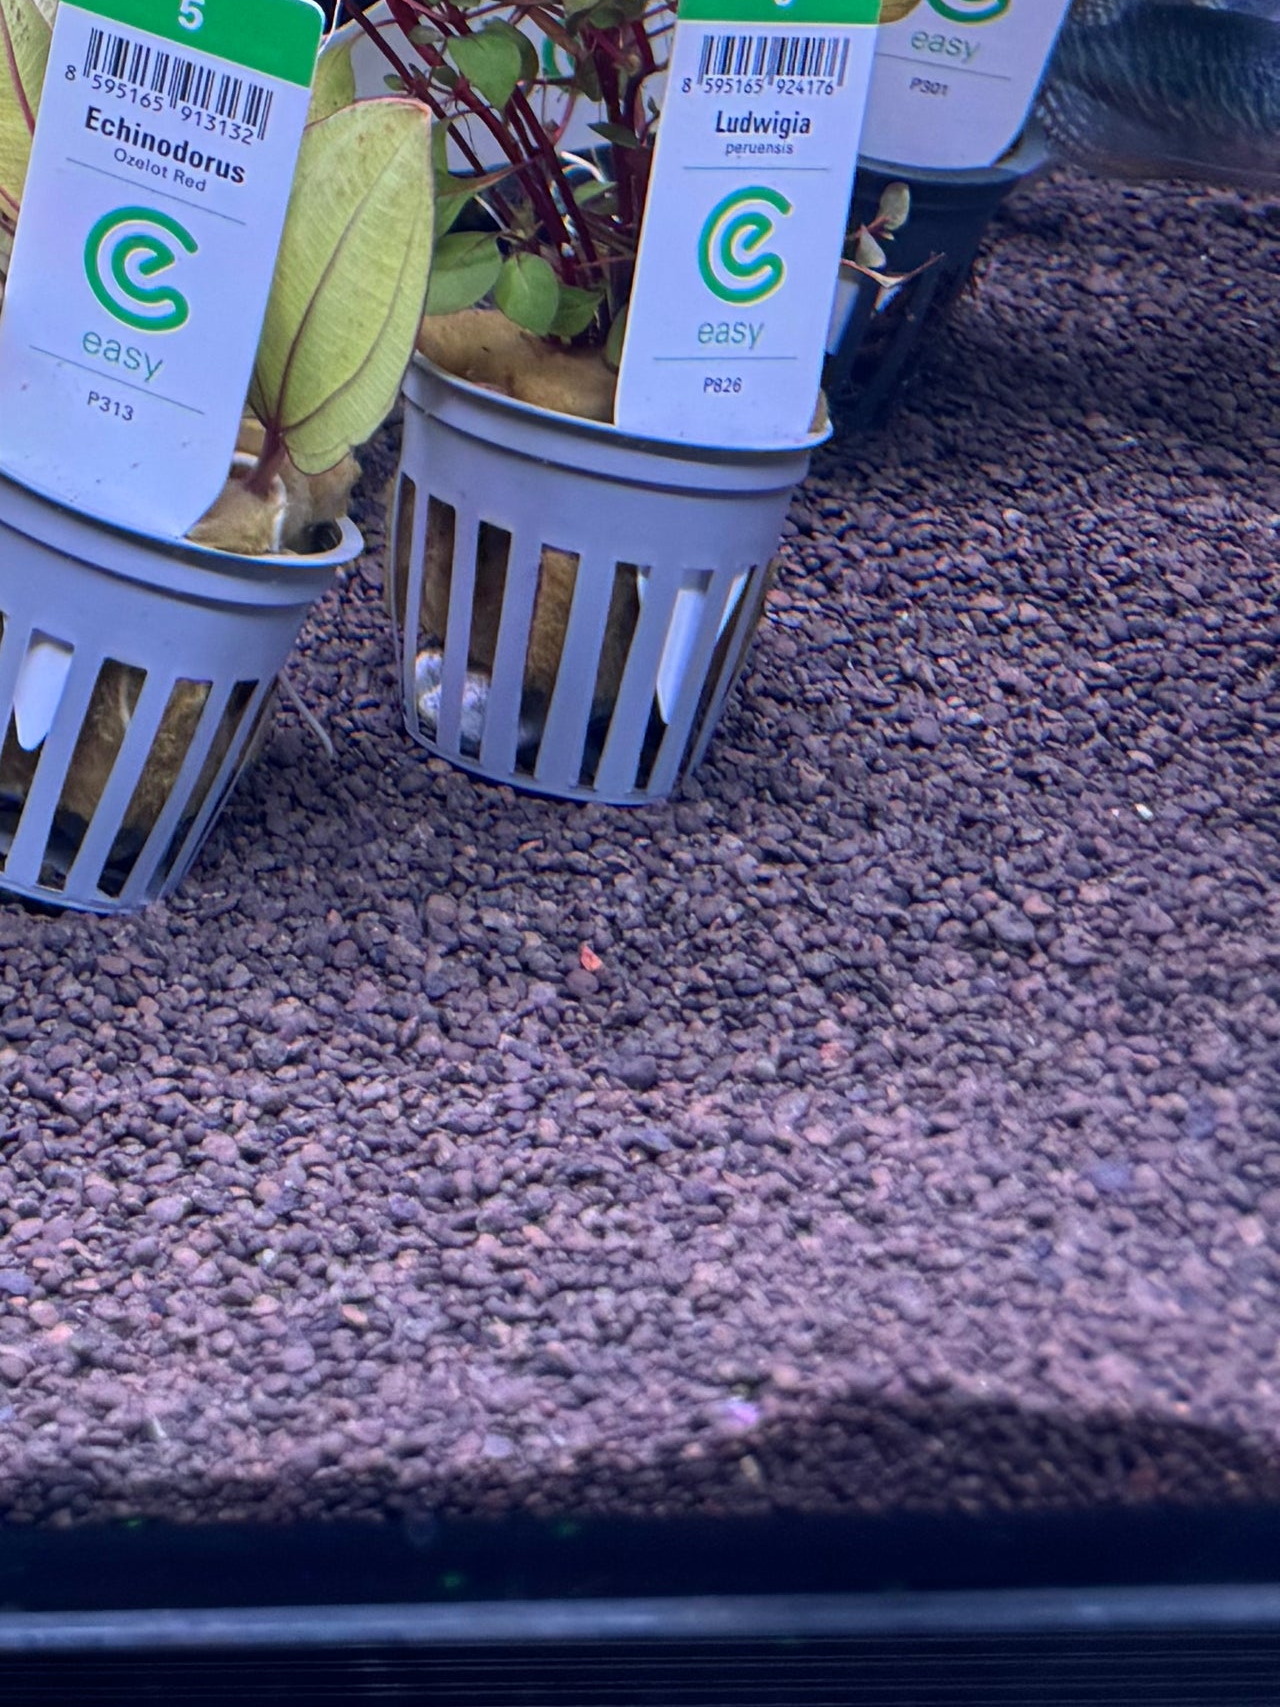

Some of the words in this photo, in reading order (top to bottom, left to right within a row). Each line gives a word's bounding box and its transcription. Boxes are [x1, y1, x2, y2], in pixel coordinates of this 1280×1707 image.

[911, 31, 981, 64] easy
[681, 78, 691, 94] 8
[704, 78, 763, 95] 595165
[776, 79, 834, 95] 924176
[65, 65, 76, 81] 8
[90, 74, 164, 112] 595165
[180, 105, 254, 146] 913132
[715, 110, 811, 139] Ludwigia
[85, 105, 246, 184] Echinodorus
[725, 142, 794, 156] peruensis
[113, 147, 168, 178] Ozelot
[173, 168, 207, 192] Red
[698, 321, 764, 350] easy
[82, 331, 163, 382] easy
[703, 377, 742, 394] P826
[87, 391, 134, 422] P313
